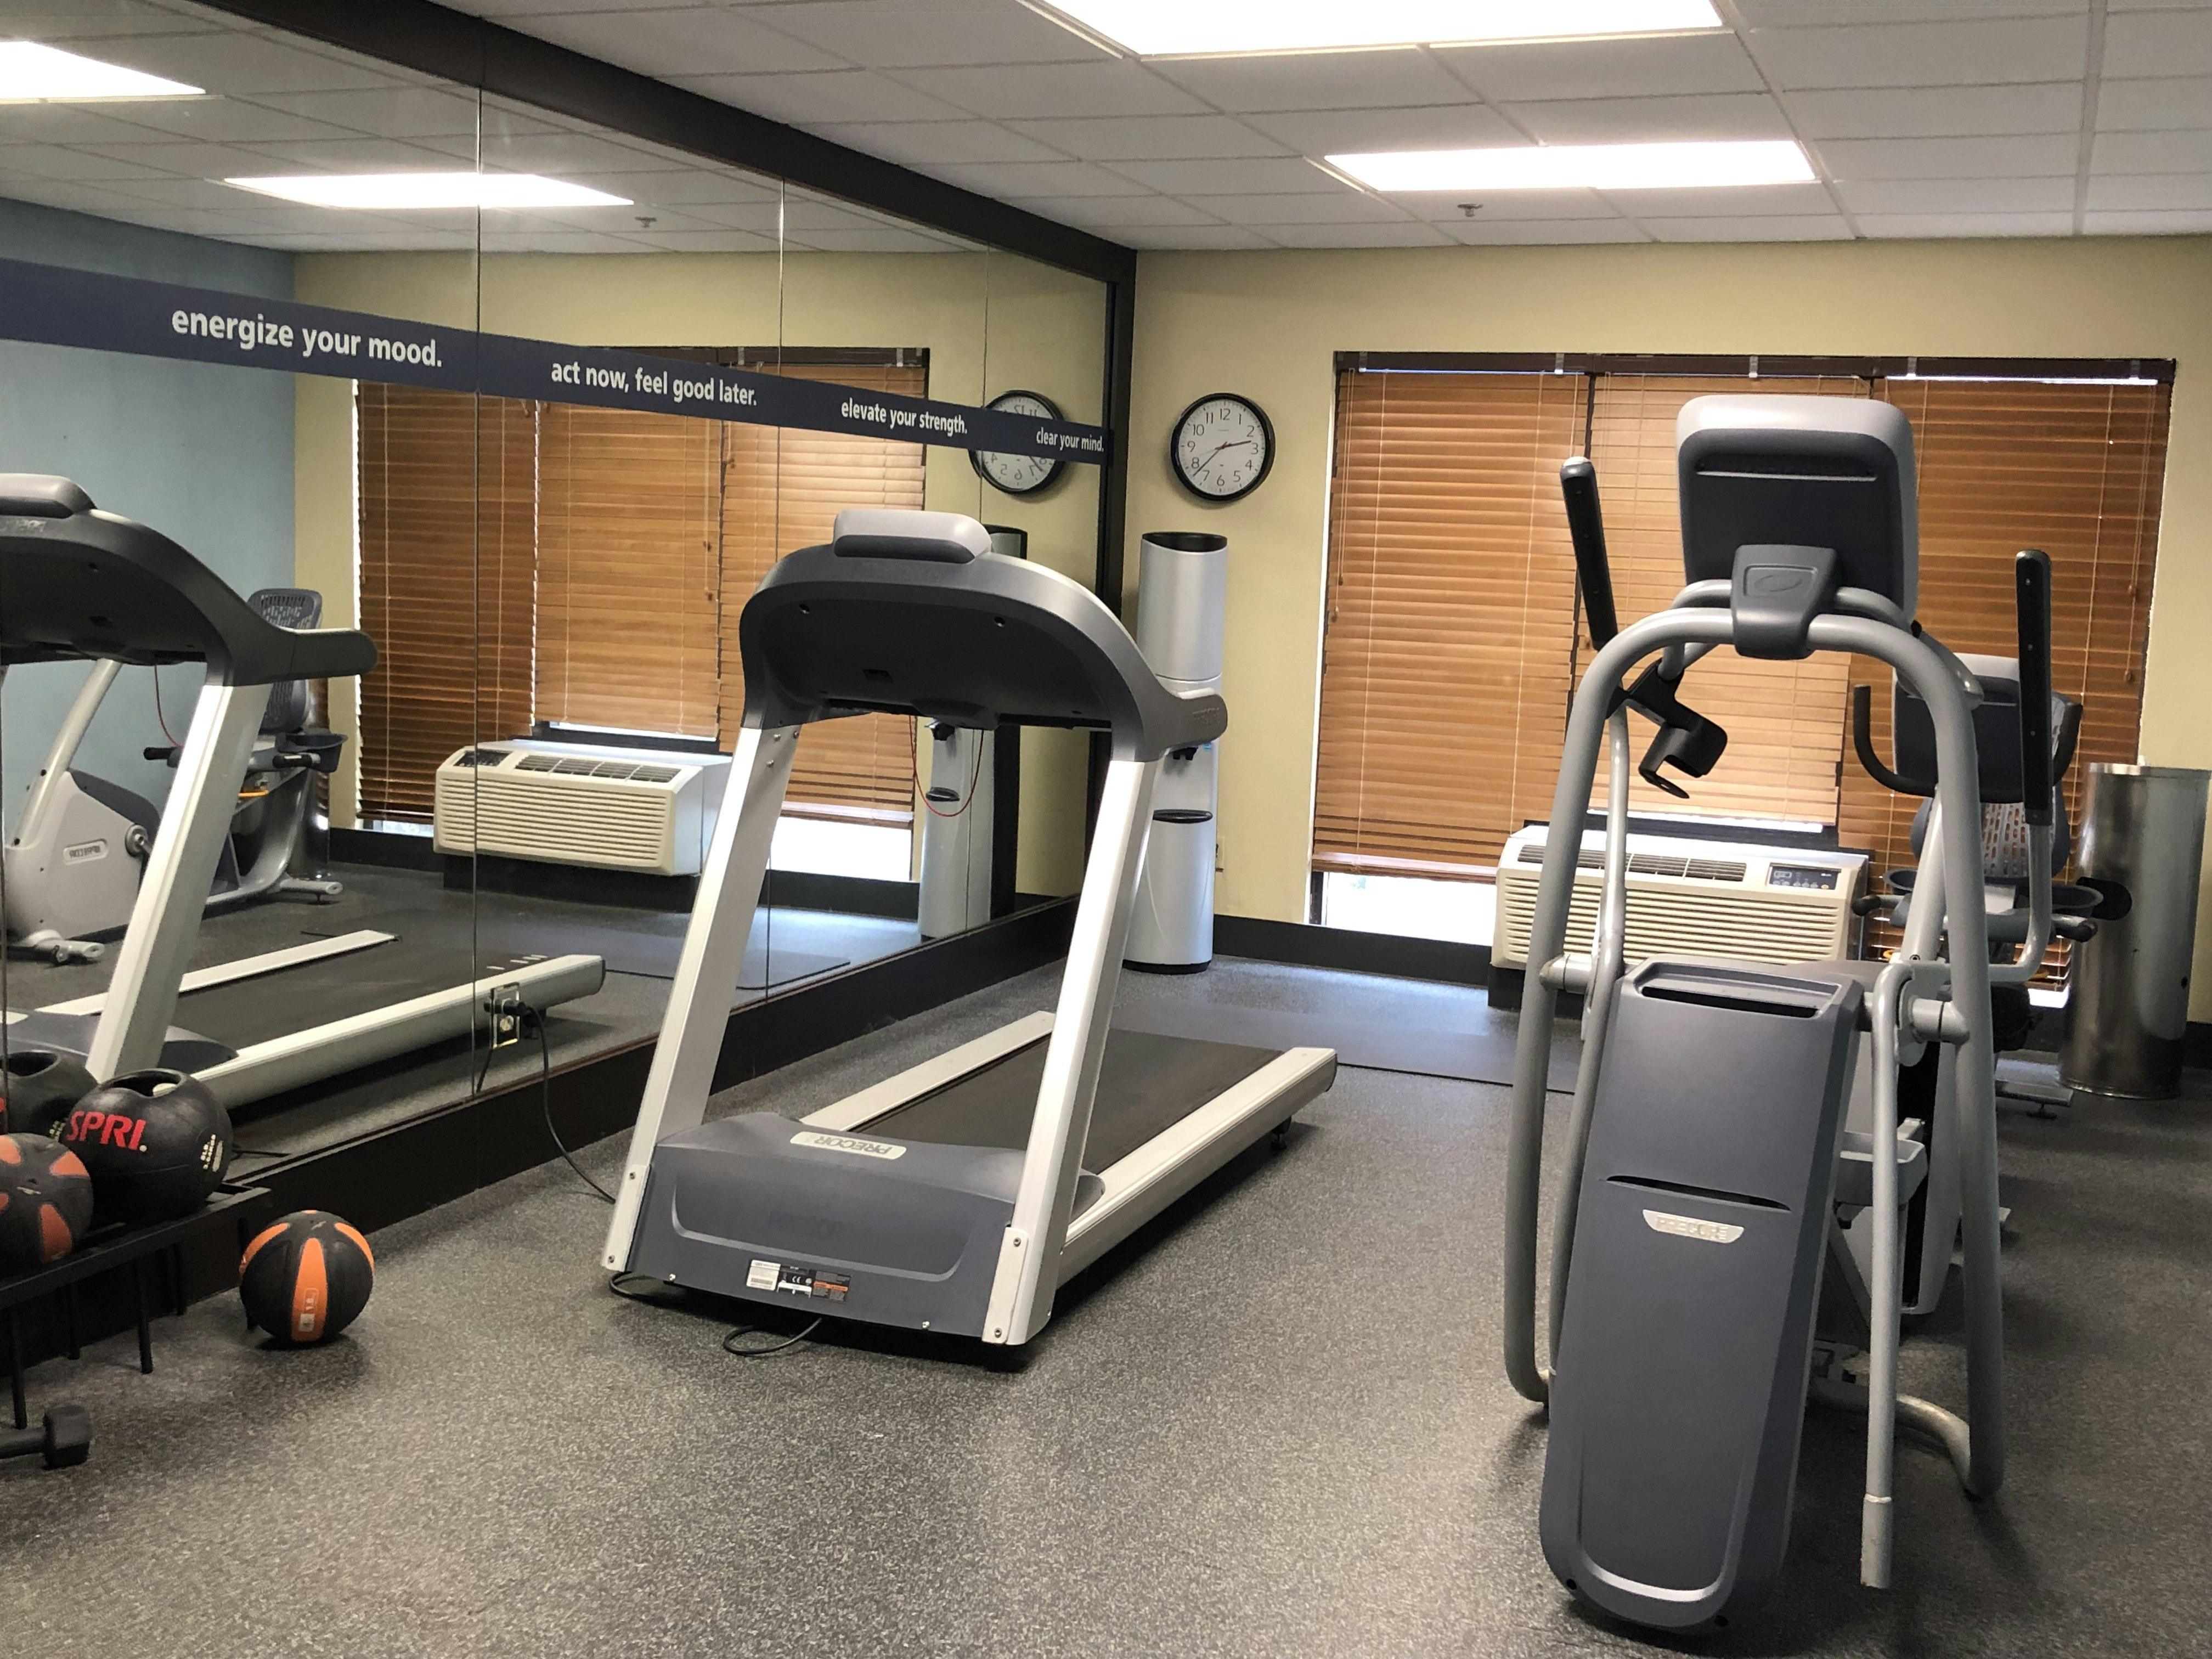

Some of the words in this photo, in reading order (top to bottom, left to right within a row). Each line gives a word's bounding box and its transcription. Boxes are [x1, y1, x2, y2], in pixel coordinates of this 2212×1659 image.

[171, 309, 295, 351] energize
[301, 328, 362, 358] your
[368, 338, 443, 368] mood.
[551, 361, 581, 385] act
[585, 367, 629, 393] now,
[635, 366, 668, 394] feel
[673, 377, 715, 403] good
[719, 379, 758, 407] later.
[840, 397, 888, 424] elevate
[889, 409, 918, 430] your
[919, 411, 968, 437] strength.
[1206, 412, 1214, 424] 11
[1220, 408, 1231, 421] 12
[1239, 413, 1242, 425] 1
[1193, 424, 1205, 436] 10
[1246, 425, 1255, 438] 2
[1036, 426, 1059, 446] clear
[1059, 434, 1080, 451] your
[1081, 434, 1104, 452] mind.
[1187, 441, 1196, 453] 9
[1251, 442, 1259, 455] 3
[1190, 457, 1200, 469] 8
[1245, 459, 1253, 471] 4
[1203, 470, 1210, 482] 7
[1216, 475, 1225, 487] 6
[1233, 470, 1242, 482] 5
[814, 1136, 893, 1154] PRECOR
